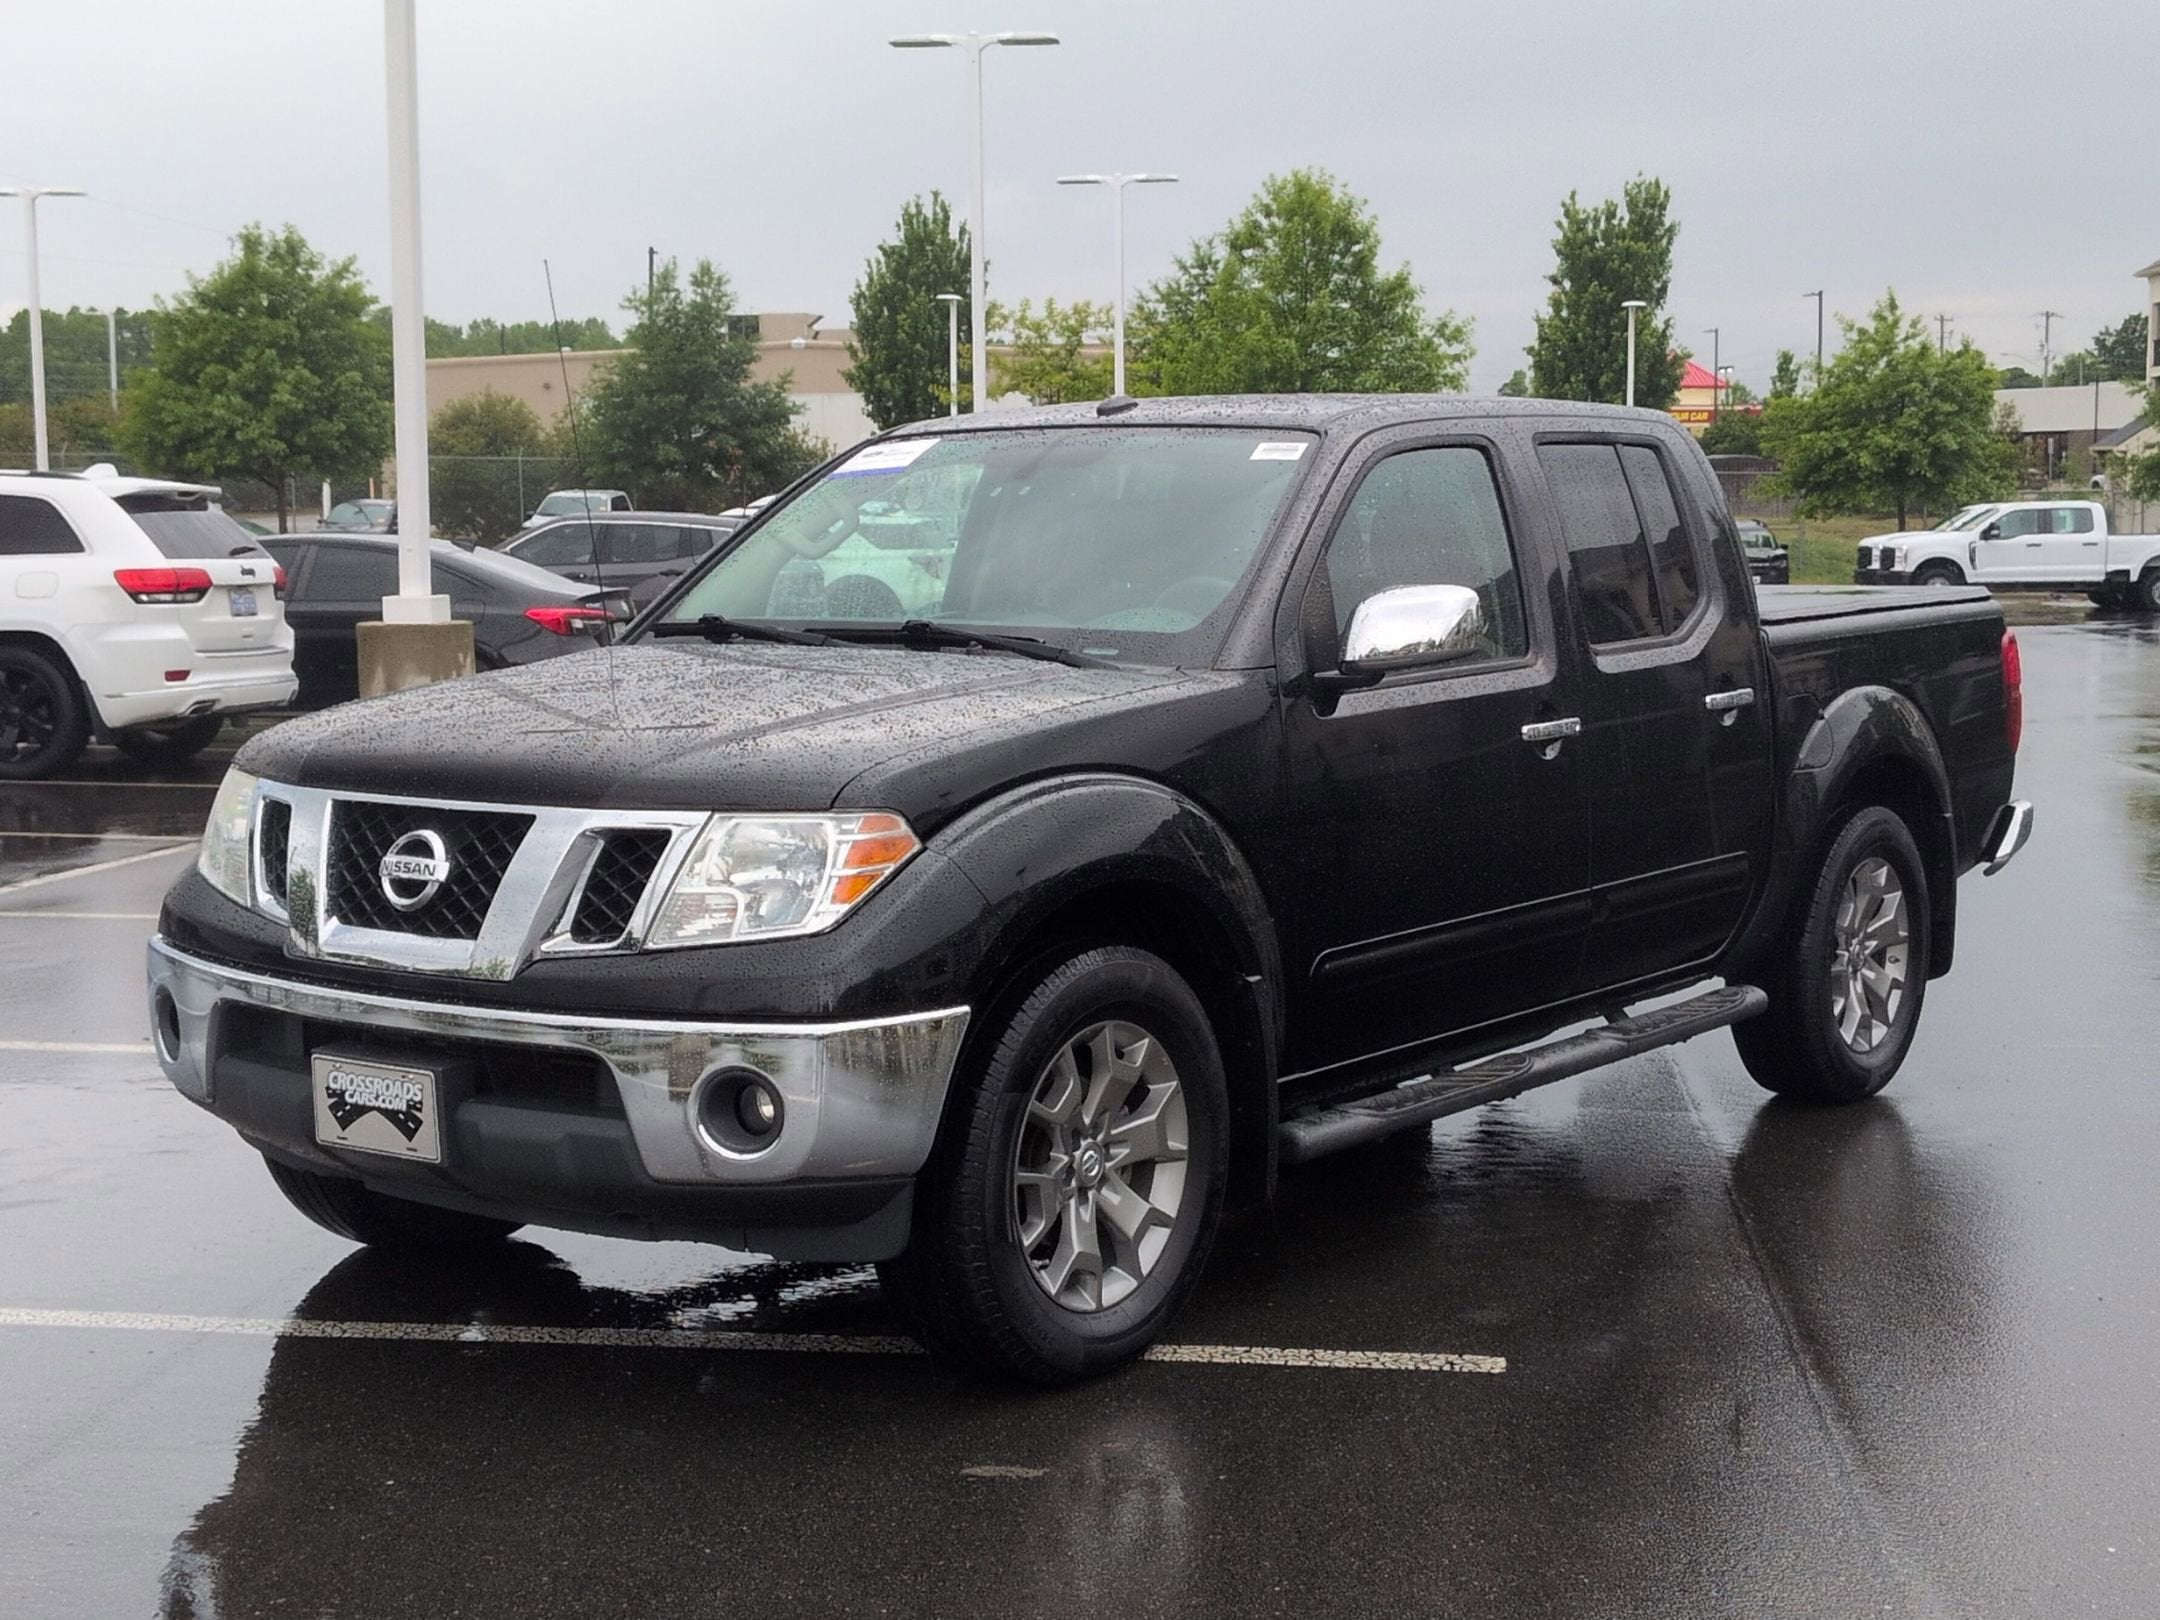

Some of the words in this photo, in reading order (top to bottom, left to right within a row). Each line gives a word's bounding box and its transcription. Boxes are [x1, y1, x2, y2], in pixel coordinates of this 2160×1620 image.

[380, 859, 436, 877] NISSAN
[328, 1070, 422, 1102] CROSSROADS
[344, 1090, 408, 1112] CARS.COM
